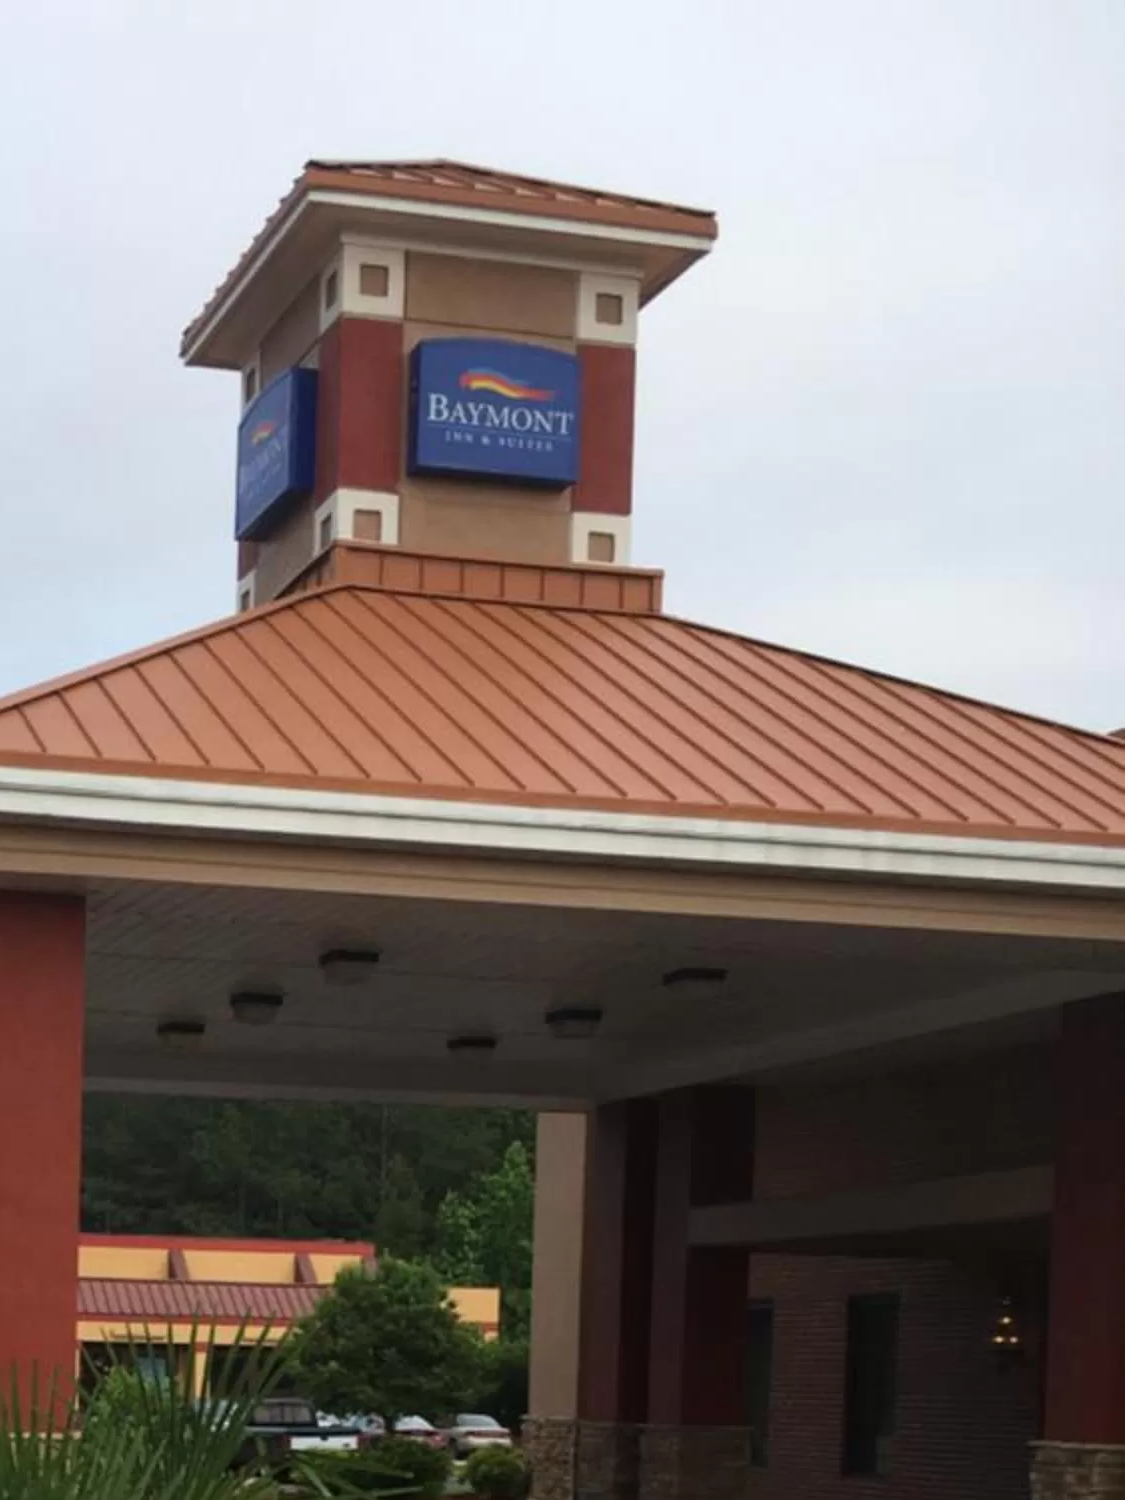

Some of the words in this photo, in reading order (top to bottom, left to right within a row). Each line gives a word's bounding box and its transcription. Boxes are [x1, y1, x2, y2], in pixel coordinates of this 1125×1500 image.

[427, 392, 575, 436] BAYMONT
[444, 430, 474, 444] INN
[481, 435, 491, 446] &
[498, 436, 554, 452] SUITES
